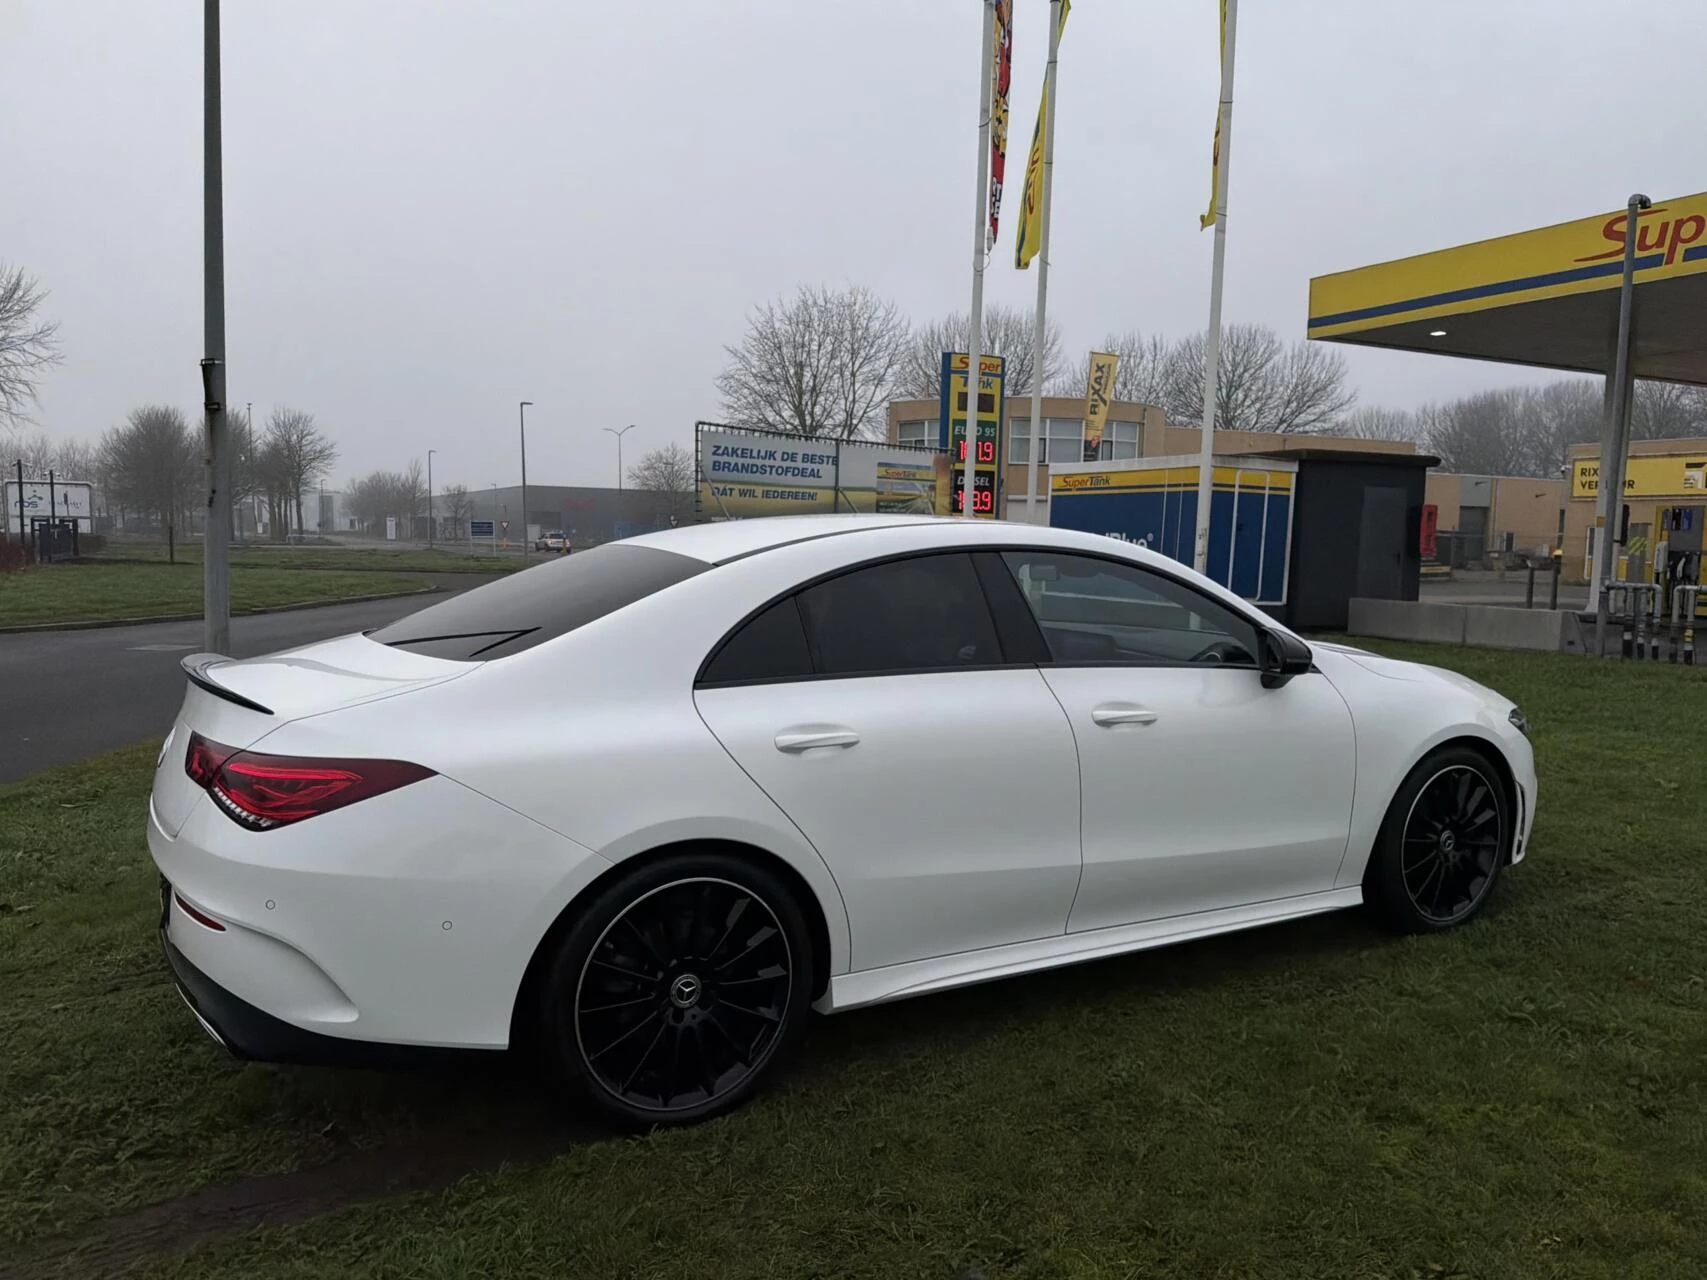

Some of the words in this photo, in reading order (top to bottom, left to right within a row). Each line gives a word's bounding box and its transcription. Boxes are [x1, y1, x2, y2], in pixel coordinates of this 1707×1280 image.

[952, 356, 1001, 375] Sper
[960, 376, 992, 389] Tnk
[954, 425, 982, 436] EUO
[984, 427, 996, 437] 95
[712, 445, 777, 461] ZAKELIJK
[781, 451, 798, 462] DE
[802, 453, 838, 466] BESTE
[712, 461, 822, 478] BRANDSTOFDEAL
[1580, 467, 1600, 477] RIX
[957, 476, 990, 486] DSEL
[738, 487, 758, 498] WIL
[761, 489, 818, 501] IEDEREEN!
